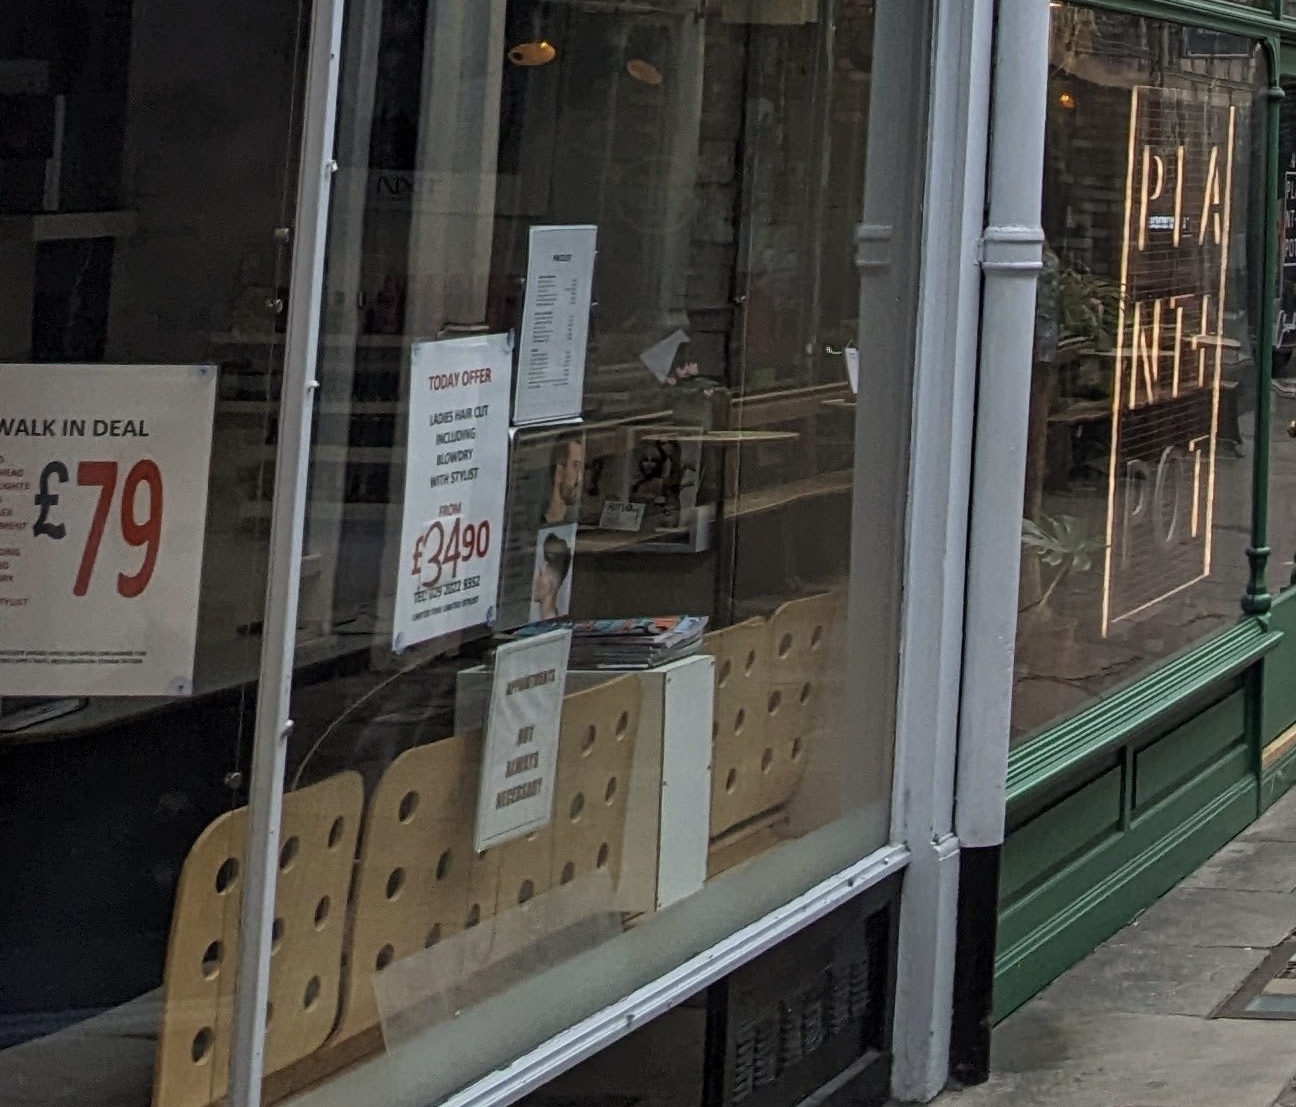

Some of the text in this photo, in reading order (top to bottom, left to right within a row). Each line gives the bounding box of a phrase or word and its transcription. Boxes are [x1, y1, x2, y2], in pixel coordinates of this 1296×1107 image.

[428, 367, 492, 391] TODAY OFFER
[429, 404, 489, 427] LADIES HAIR CUT
[0, 418, 150, 437] WALK IN DEAL
[436, 427, 476, 446] INCLUDING
[450, 467, 480, 484] STYLIST
[32, 459, 164, 598] £79
